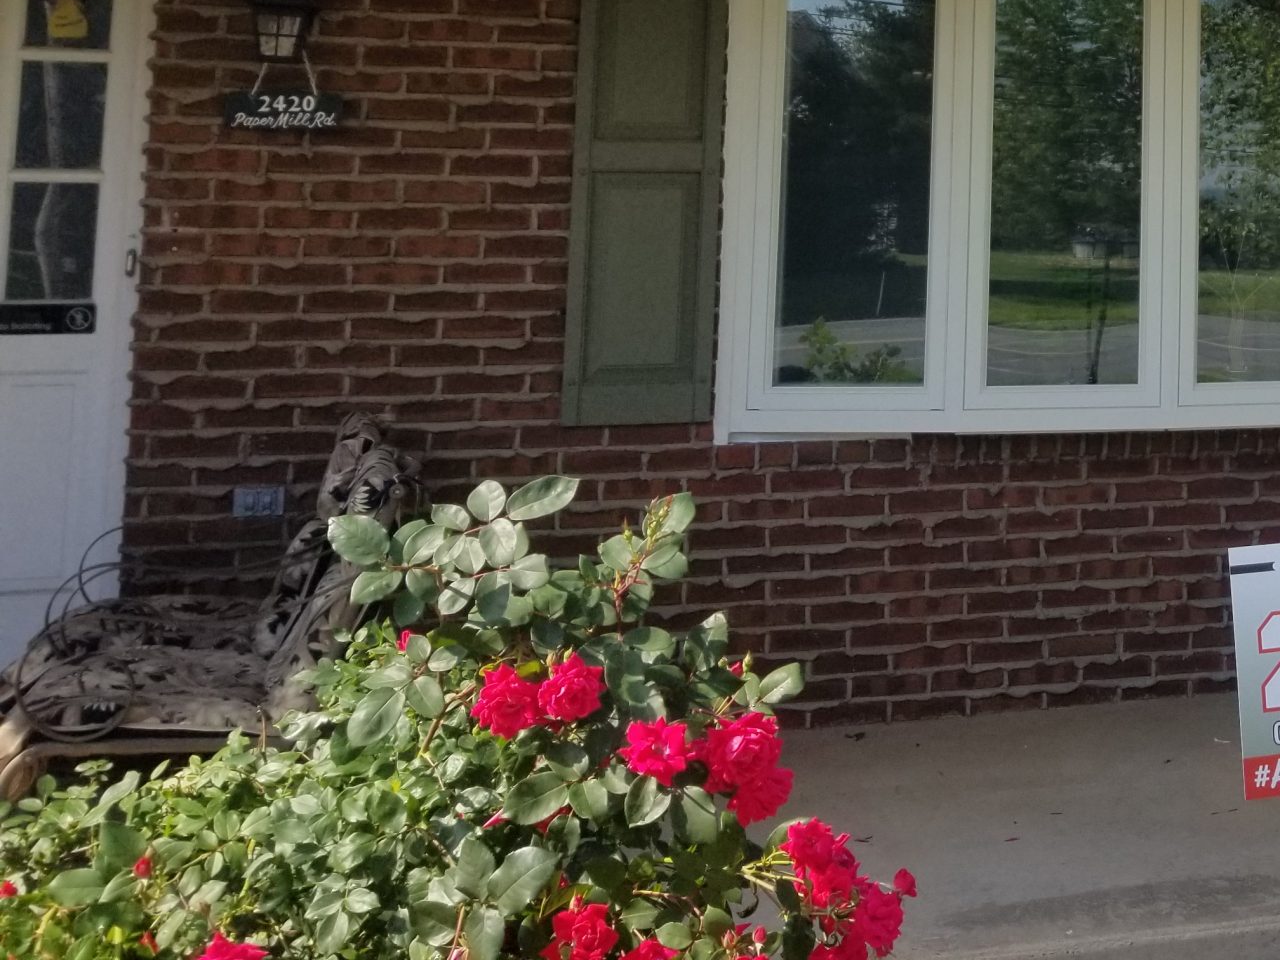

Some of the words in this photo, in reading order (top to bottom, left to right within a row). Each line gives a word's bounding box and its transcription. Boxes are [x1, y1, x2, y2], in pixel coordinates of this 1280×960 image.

[257, 95, 316, 112] 2420
[231, 112, 274, 128] Paper
[271, 113, 310, 128] Mill
[308, 112, 337, 128] Rd.
